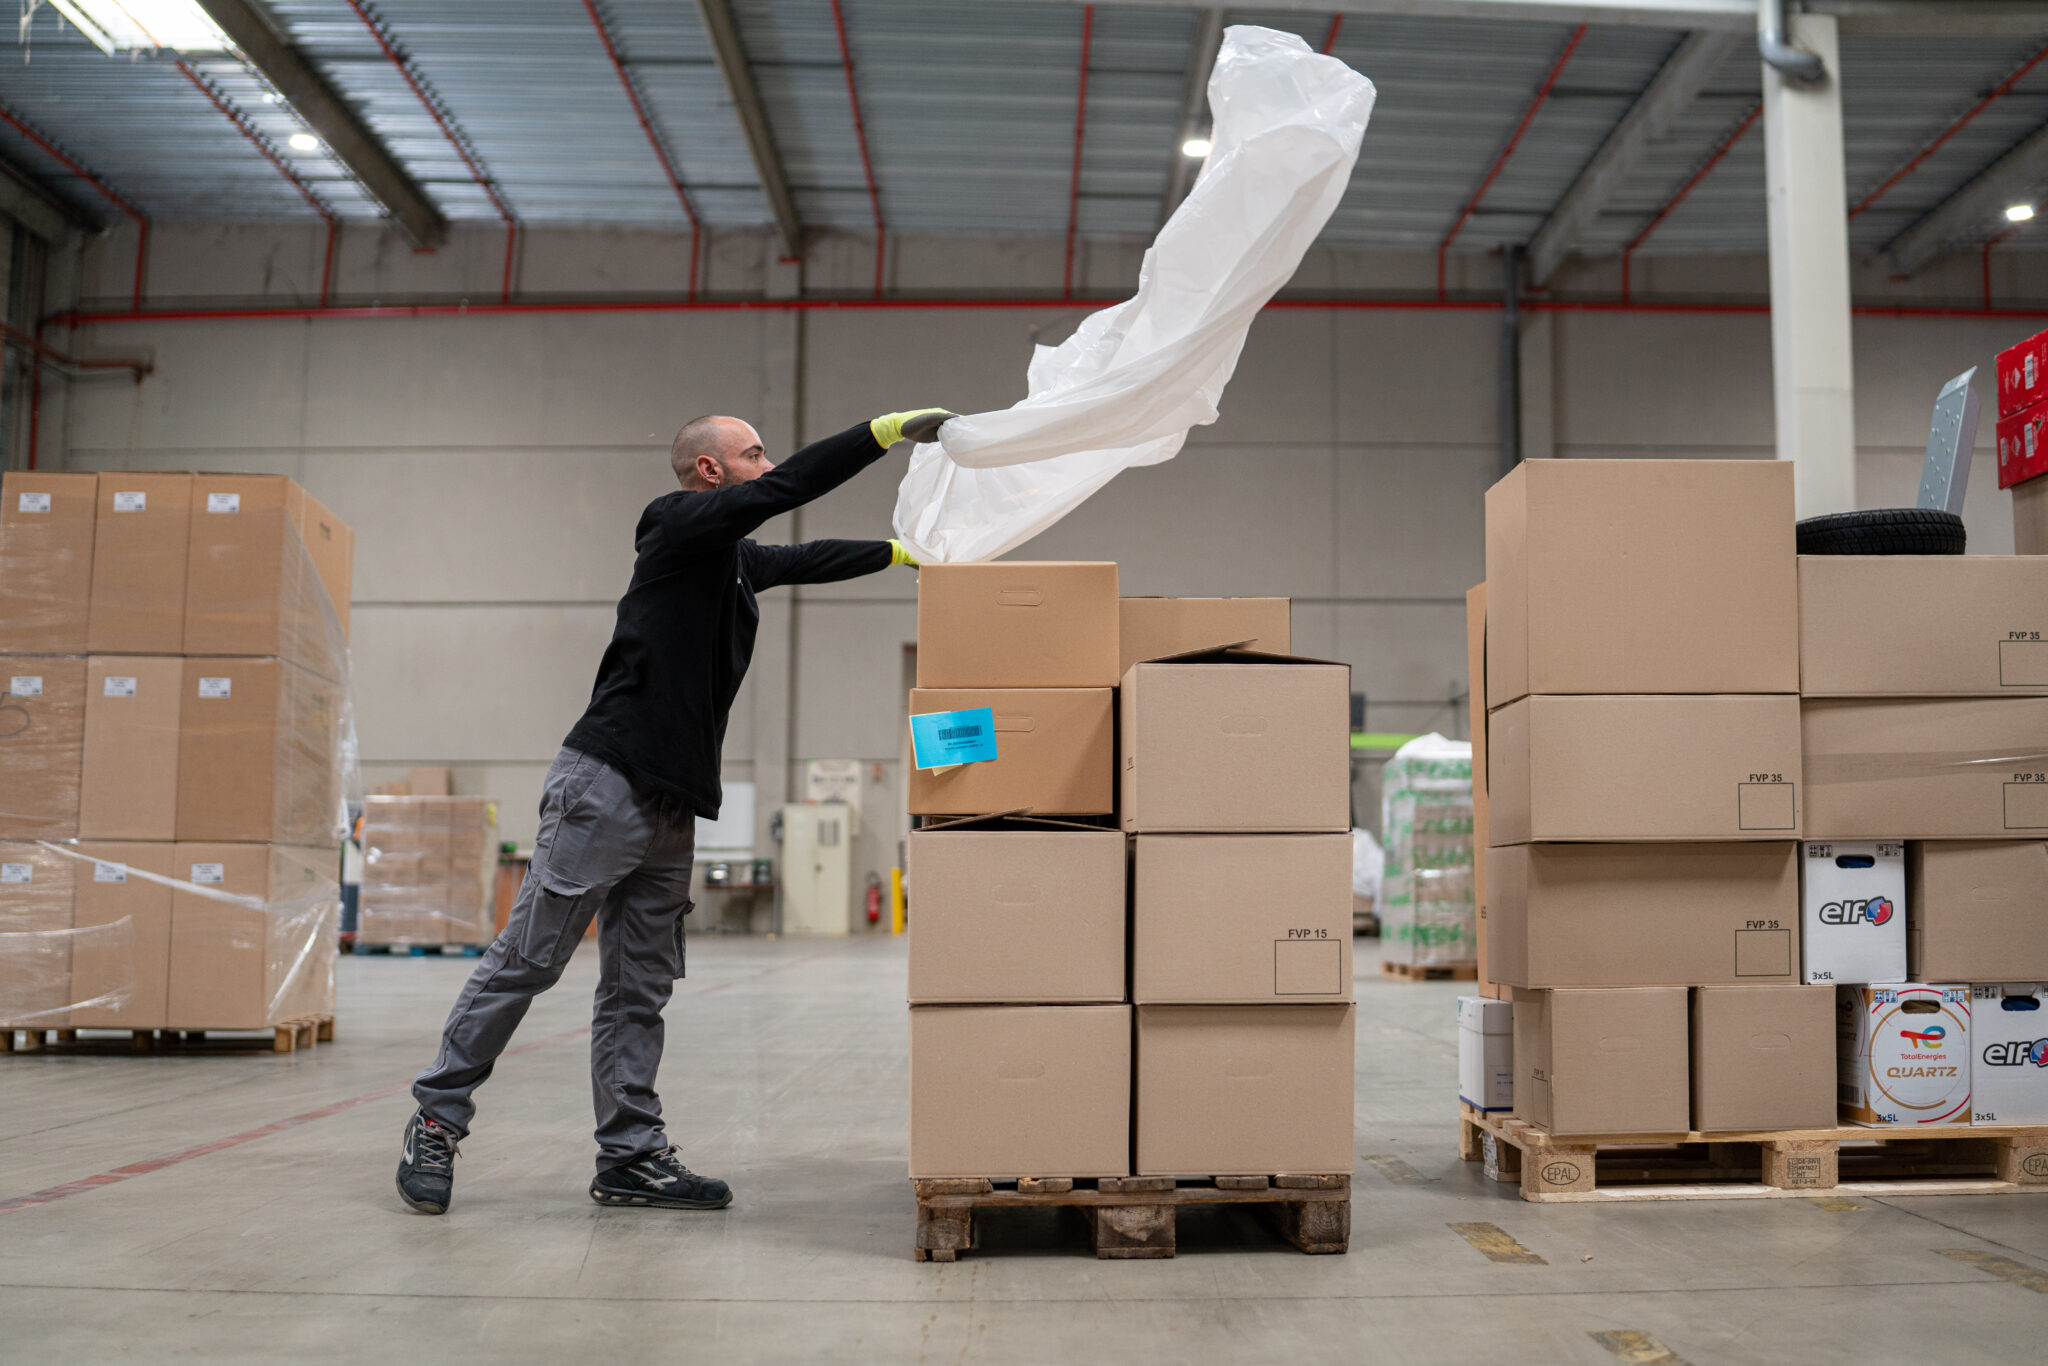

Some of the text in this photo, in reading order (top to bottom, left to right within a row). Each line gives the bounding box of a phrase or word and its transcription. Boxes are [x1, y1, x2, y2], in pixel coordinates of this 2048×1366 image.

[2009, 631, 2041, 640] FVP 35
[1749, 773, 1783, 782] FVP 35
[2013, 773, 2046, 782] FVP 35
[1819, 899, 1868, 925] elf
[1746, 920, 1780, 929] FVP 35
[1288, 928, 1328, 938] FVP 15
[1812, 971, 1834, 980] 3x5L
[1900, 1053, 1947, 1061] TotalEnergies
[1983, 1041, 2033, 1066] elf
[1887, 1066, 1958, 1078] QUARTZ
[1876, 1113, 1899, 1122] 3x5L
[1974, 1112, 1997, 1121] 3x5L
[2028, 1159, 2048, 1173] EPA
[1547, 1167, 1576, 1181] EPAL
